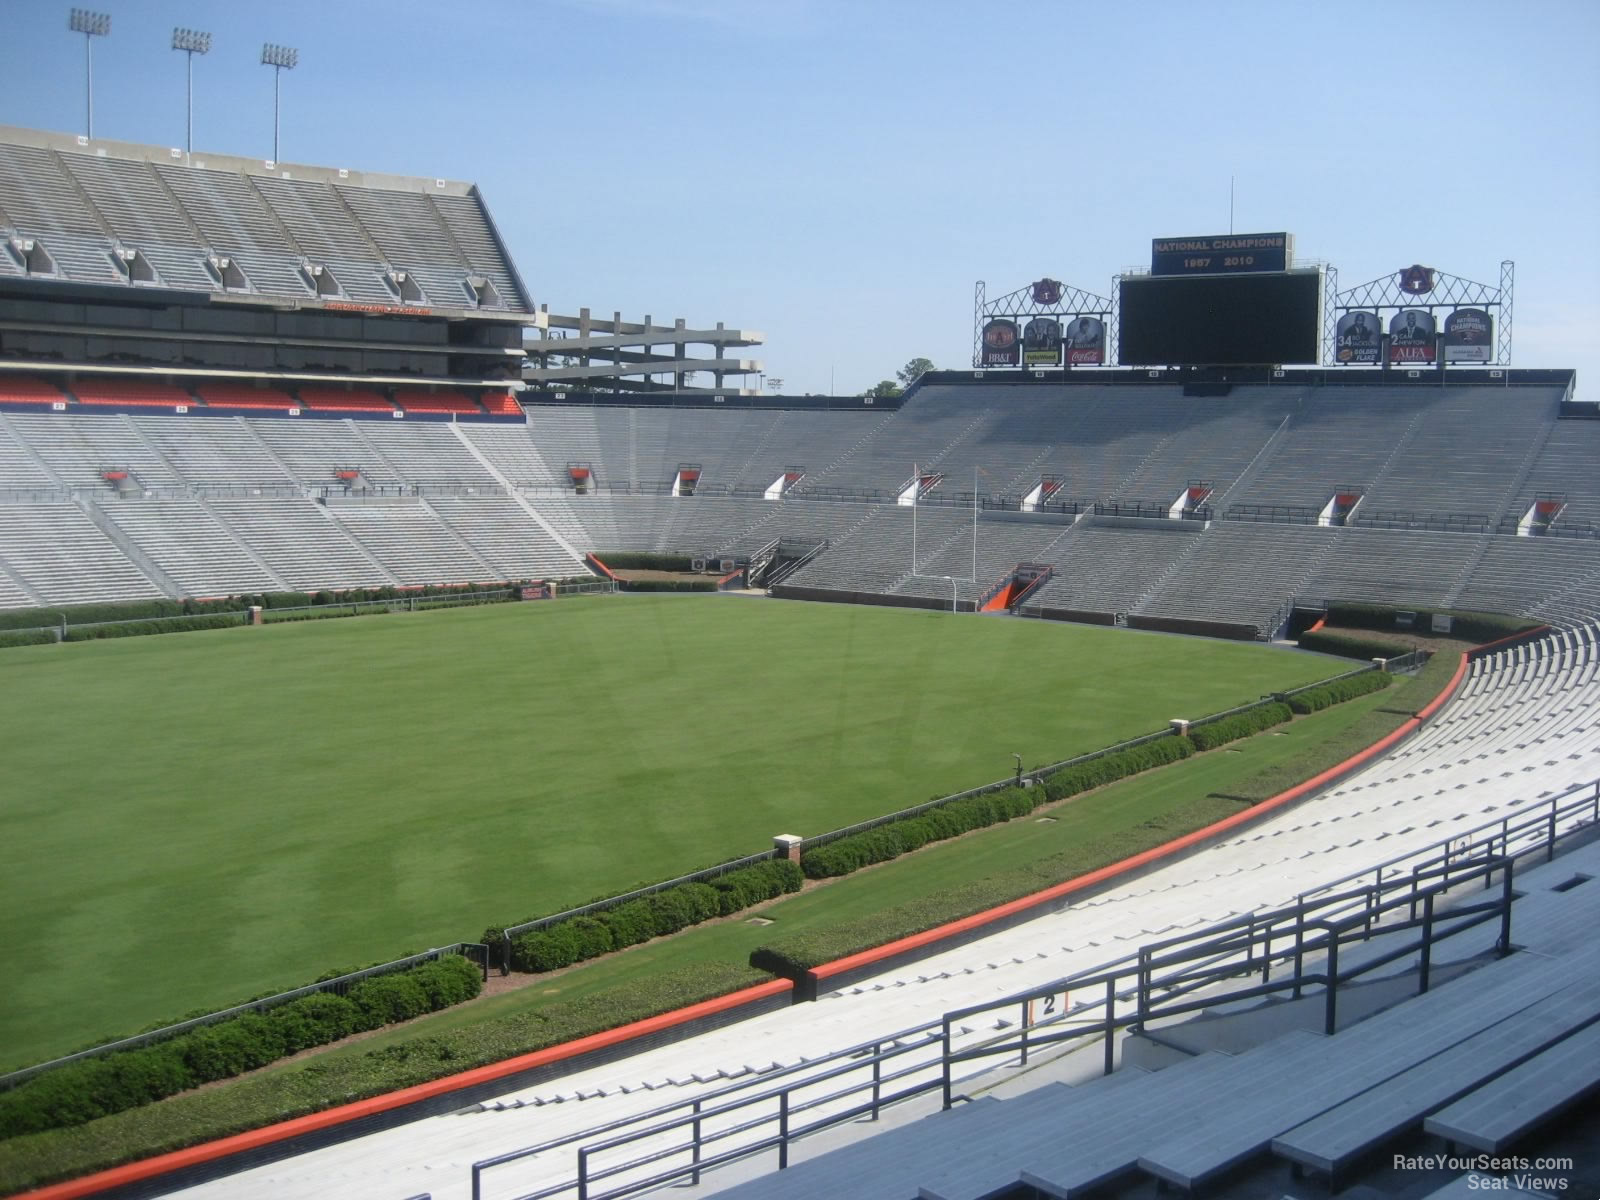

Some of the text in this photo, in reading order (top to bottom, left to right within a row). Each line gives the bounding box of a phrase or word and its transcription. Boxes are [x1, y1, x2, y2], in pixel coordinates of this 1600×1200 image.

[1155, 238, 1284, 252] NATIONAL CHAMPIONS
[1184, 256, 1254, 268] 1957 2010
[1456, 317, 1481, 325] NATIONAL
[1450, 323, 1487, 332] CHAMPIONS
[1067, 339, 1075, 349] 7
[1338, 335, 1352, 347] 34
[1391, 334, 1399, 346] 2
[988, 353, 1012, 363] BB&T
[1071, 351, 1098, 362] Coca-Cola
[1396, 347, 1425, 358] ALFA
[1043, 994, 1055, 1015] 2
